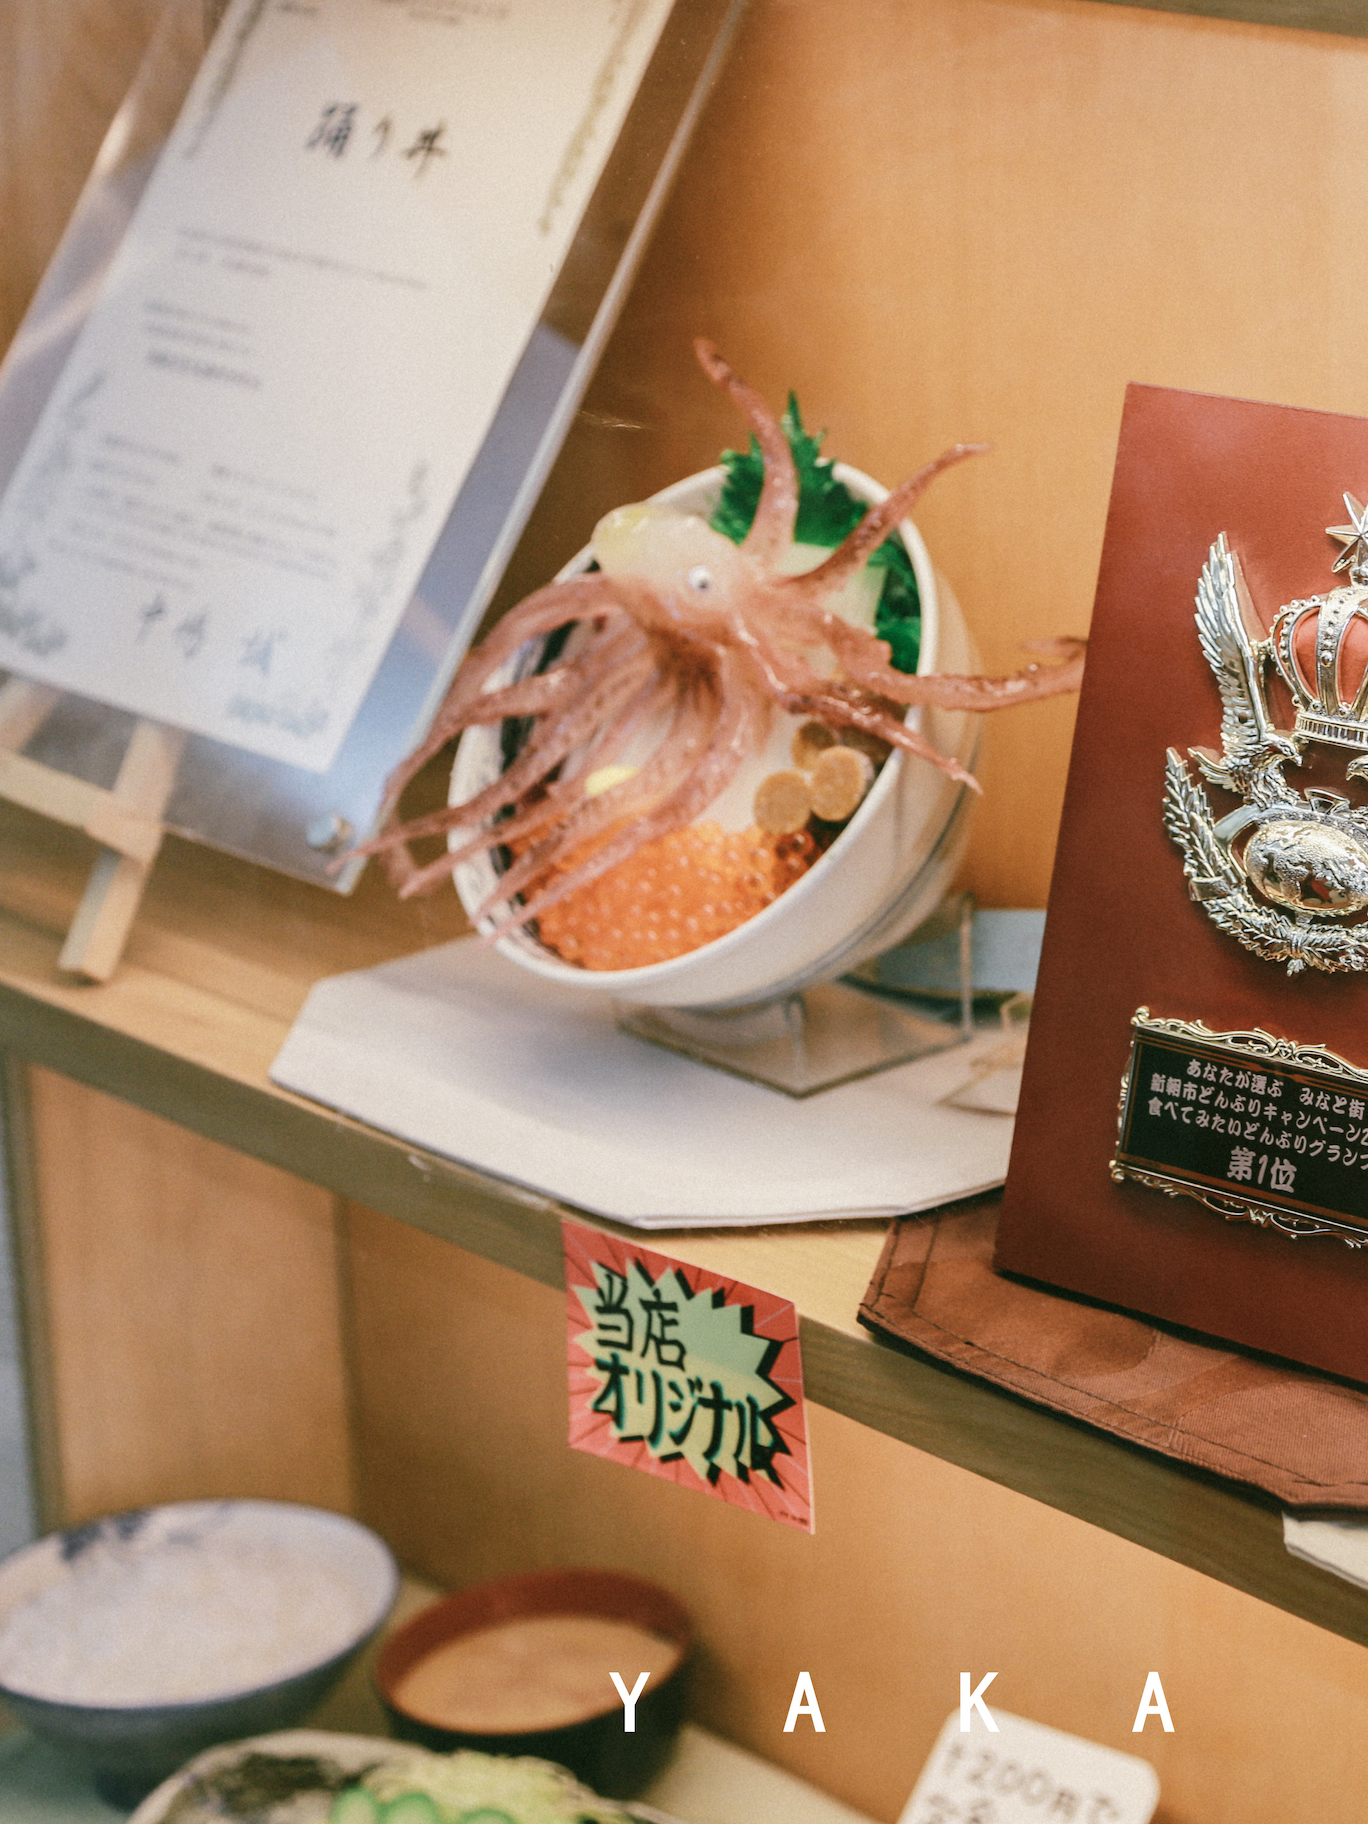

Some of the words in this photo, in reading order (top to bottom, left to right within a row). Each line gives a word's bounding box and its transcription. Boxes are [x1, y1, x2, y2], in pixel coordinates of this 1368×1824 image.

[1186, 1058, 1284, 1098] あなたが選ぶ
[1299, 1086, 1365, 1121] みなと街
[1226, 1146, 1297, 1194] 第1位
[594, 1272, 687, 1371] 当店
[591, 1352, 776, 1470] オリジナル
